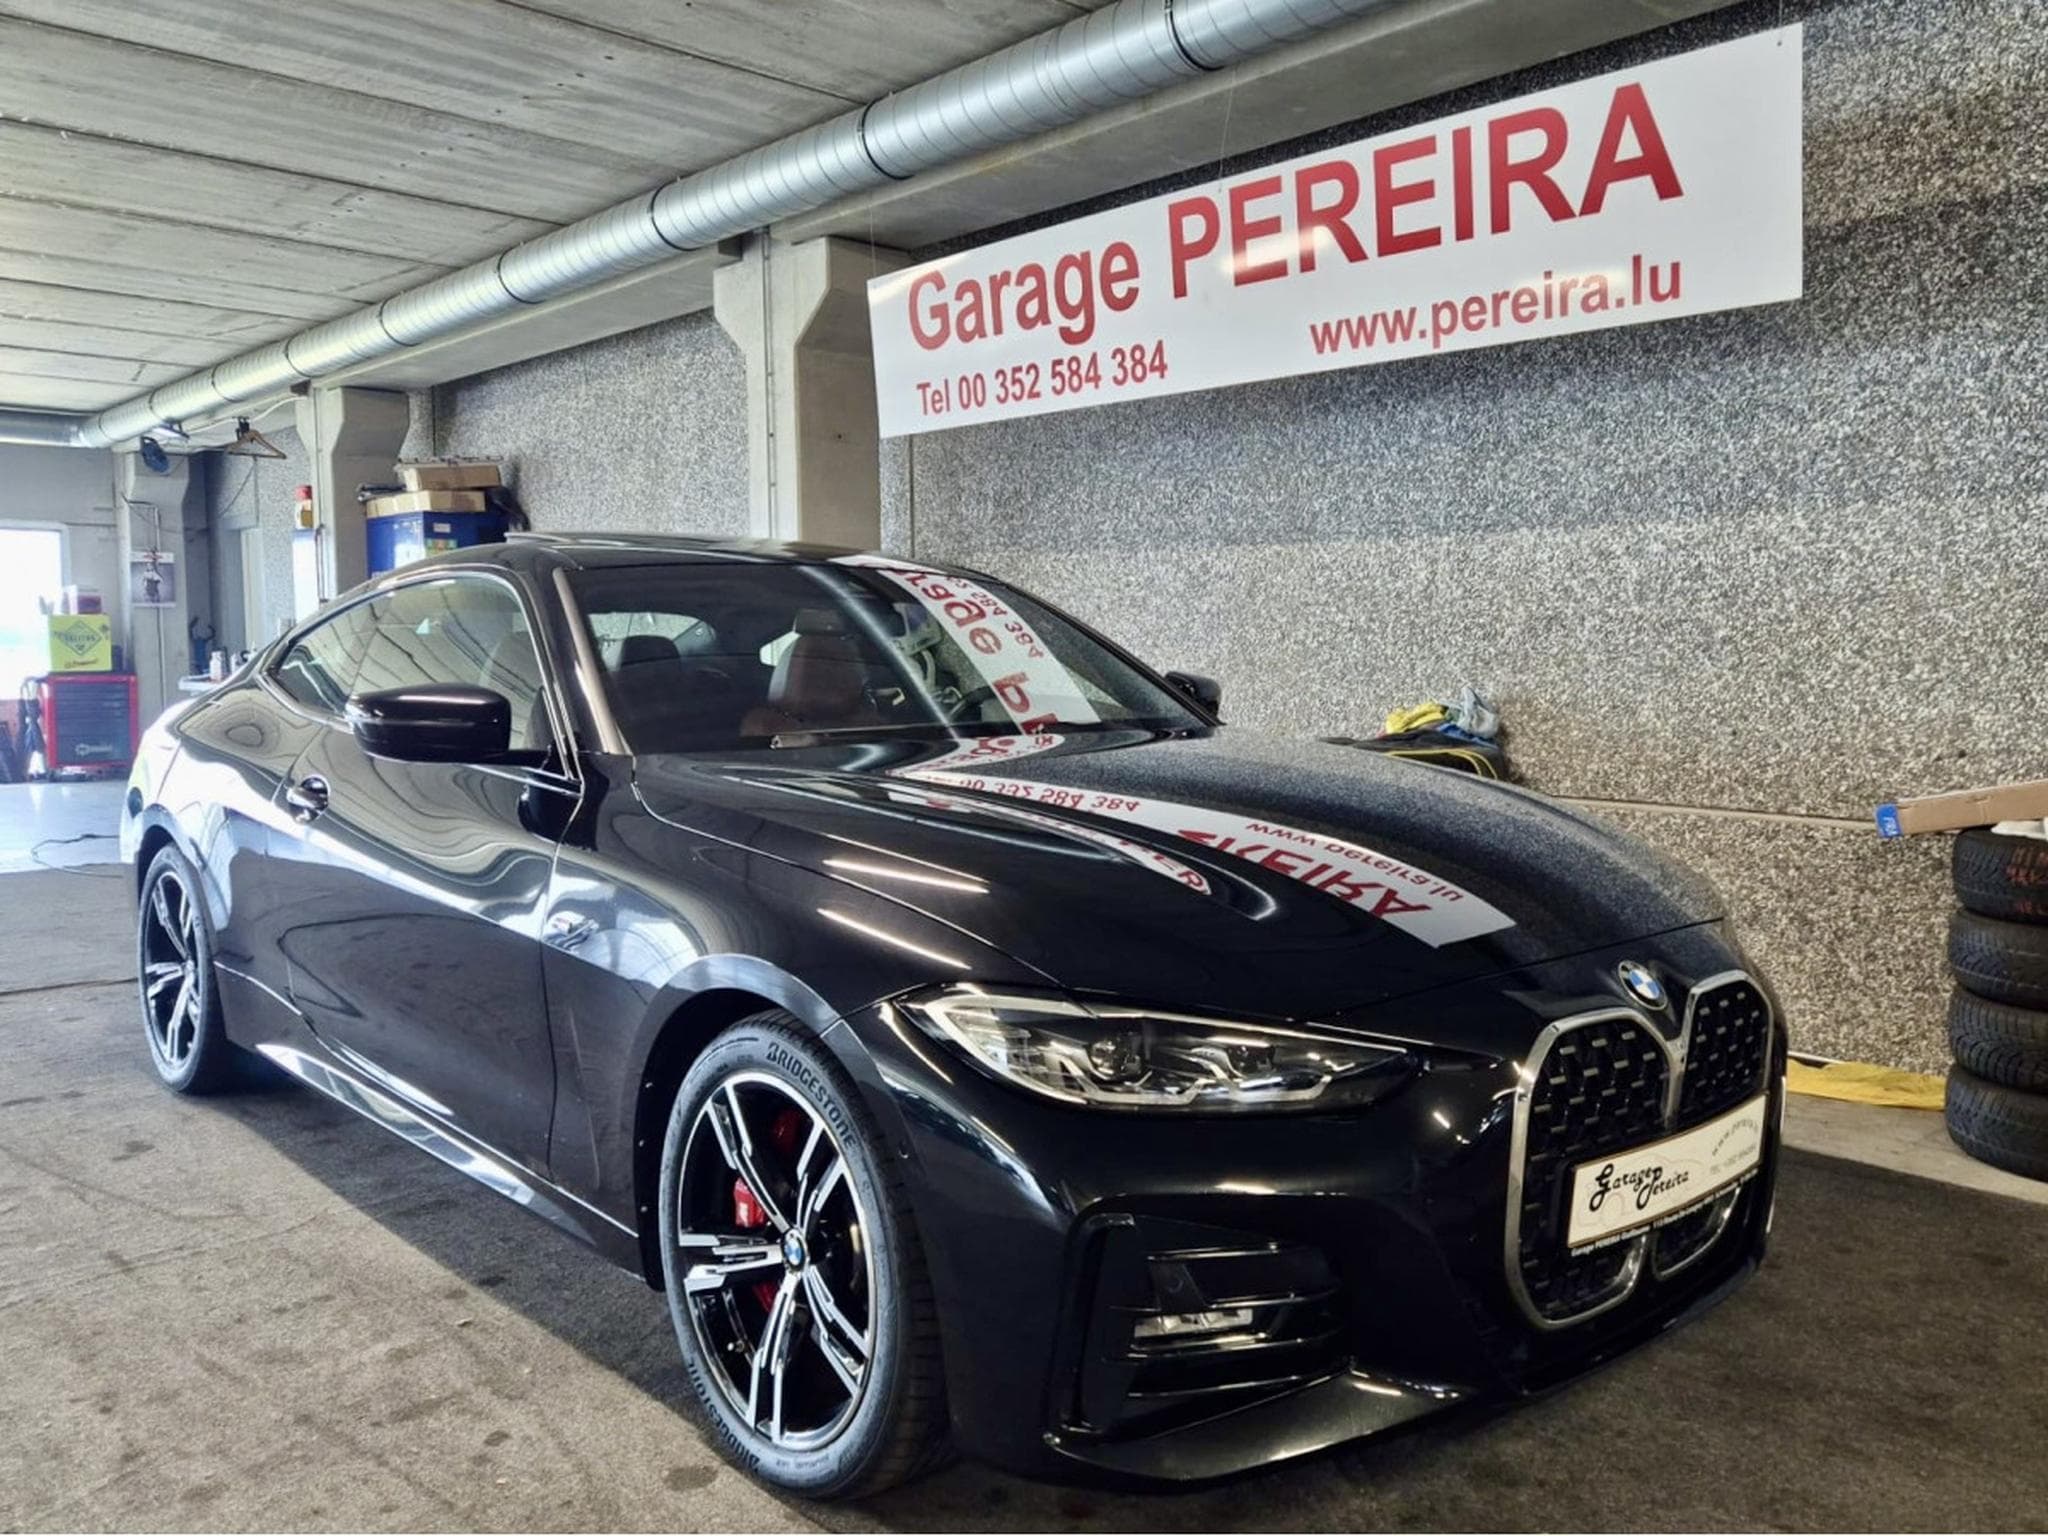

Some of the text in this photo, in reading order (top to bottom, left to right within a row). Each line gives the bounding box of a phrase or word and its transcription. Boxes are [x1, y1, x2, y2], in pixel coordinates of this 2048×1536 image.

[908, 82, 1685, 350] Garage PEREIRA
[1310, 255, 1683, 356] www.pereira.lu
[916, 341, 1169, 416] Tel 00 352 584 384
[765, 1041, 857, 1150] BRIDGESTONE
[1588, 1163, 1653, 1212] Garage
[1635, 1165, 1690, 1210] Pereira
